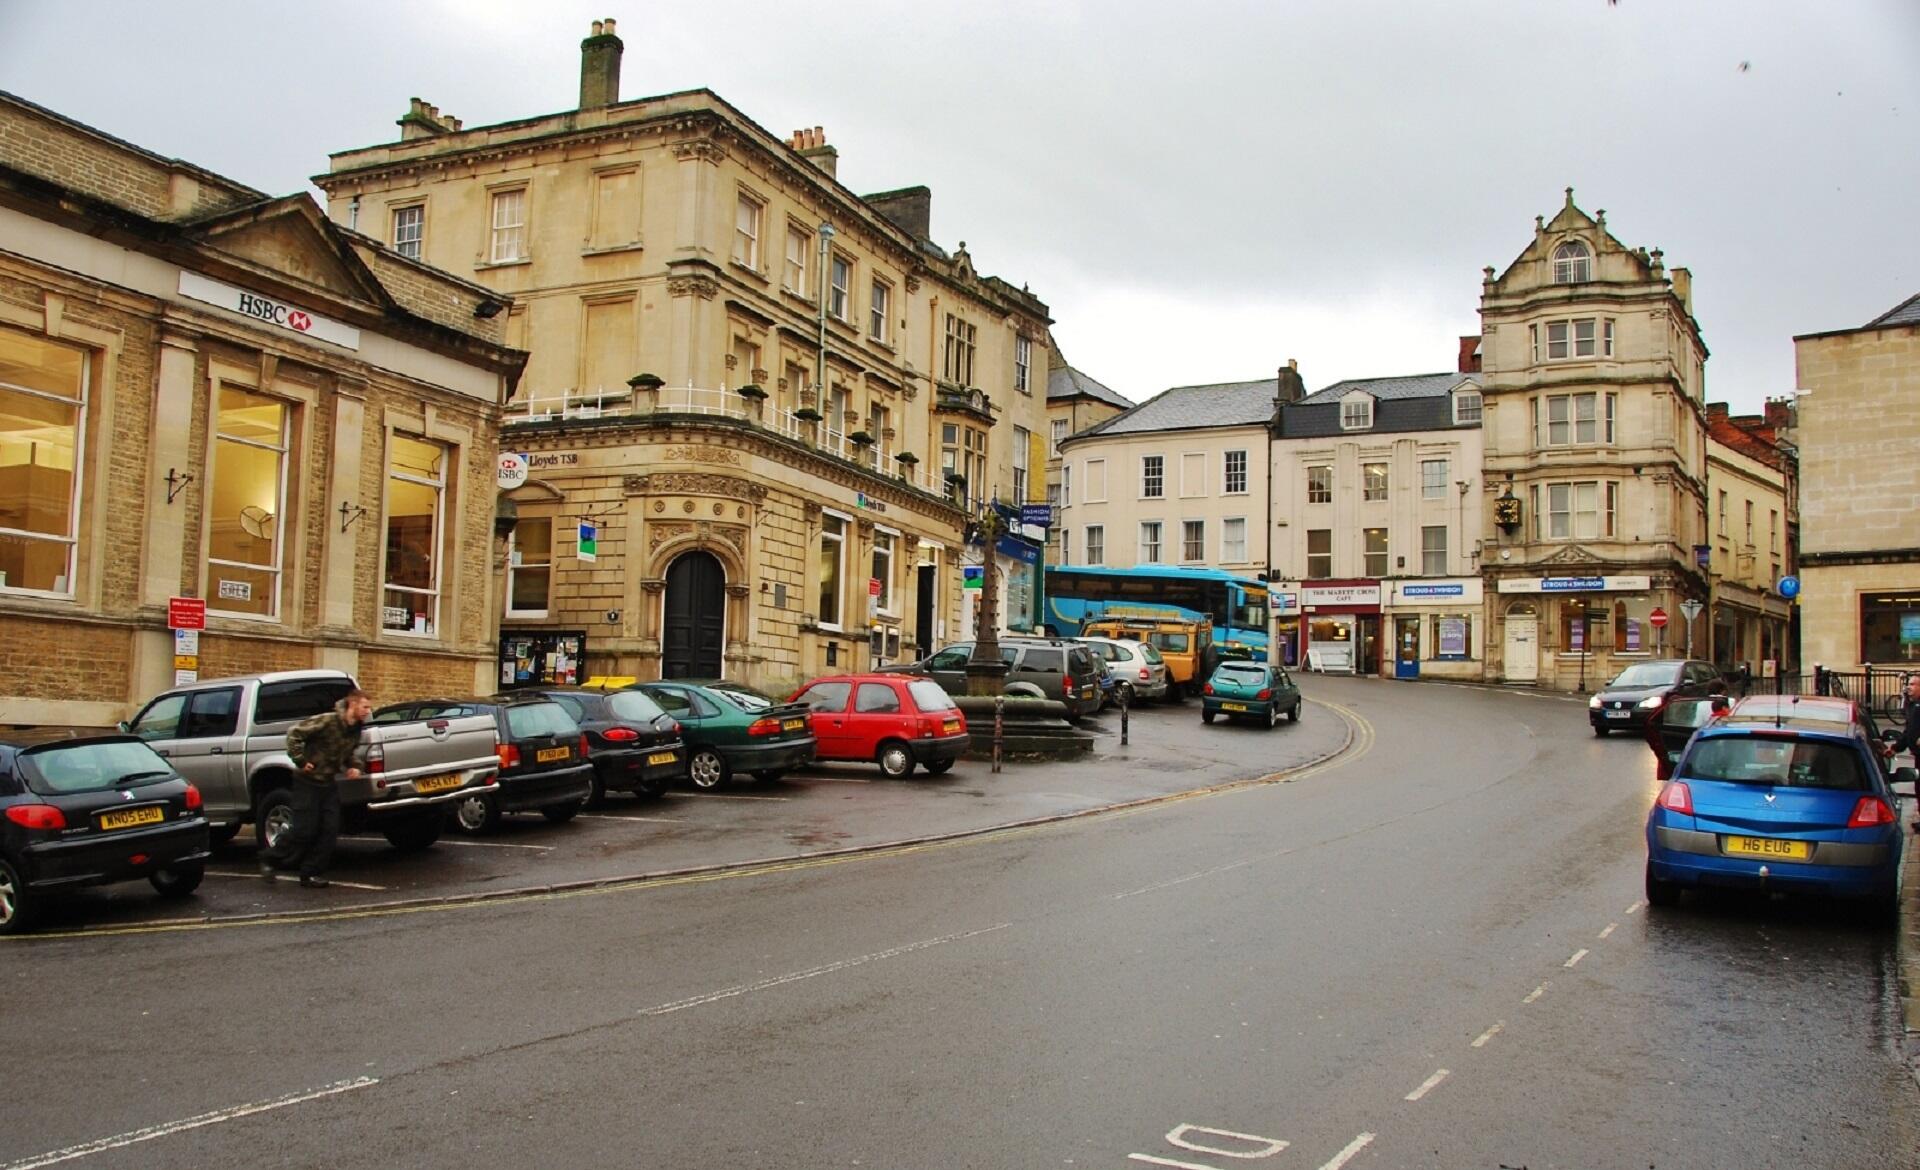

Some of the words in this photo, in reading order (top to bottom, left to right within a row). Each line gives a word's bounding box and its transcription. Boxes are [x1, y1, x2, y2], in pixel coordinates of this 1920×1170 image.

[238, 293, 286, 324] HSBC
[529, 454, 558, 468] Lloyds
[560, 453, 578, 464] TSB
[1743, 839, 1760, 851] H6
[1764, 840, 1791, 854] EUG
